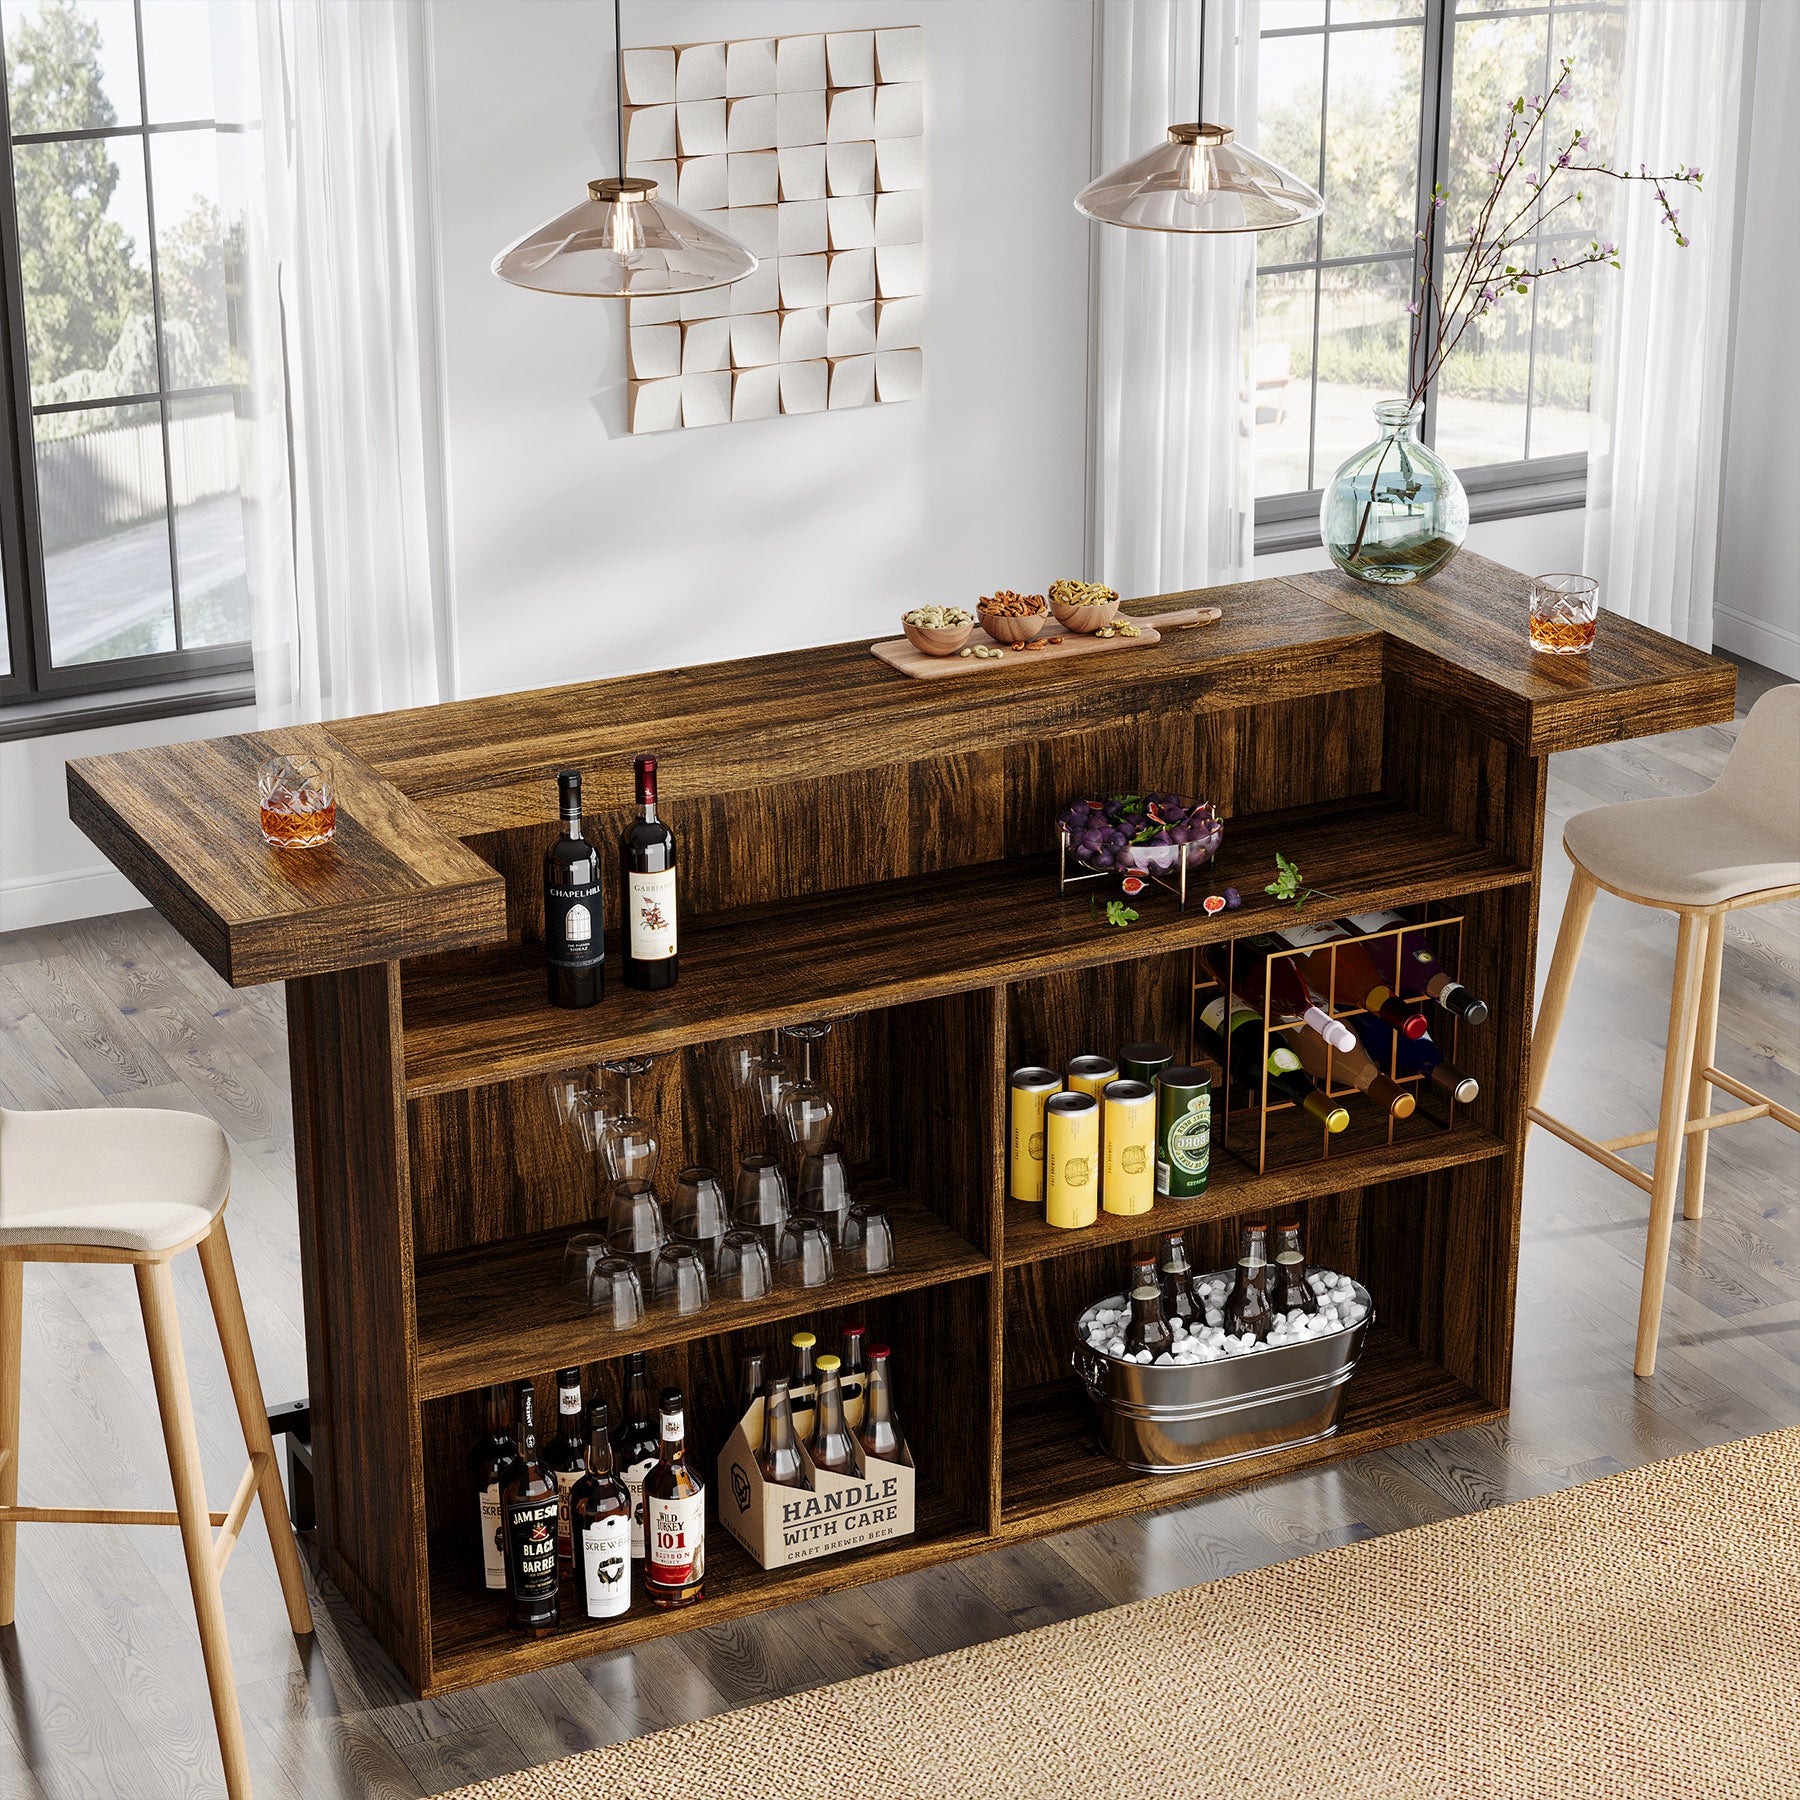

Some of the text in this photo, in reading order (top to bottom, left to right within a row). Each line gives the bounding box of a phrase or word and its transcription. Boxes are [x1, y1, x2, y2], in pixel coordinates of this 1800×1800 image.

[550, 885, 601, 898] CHAPEL HILL
[783, 1477, 897, 1523] HANDLE
[656, 1518, 685, 1532] TURKEY
[659, 1511, 678, 1522] WILD
[783, 1505, 897, 1546] WITH CARE
[657, 1532, 686, 1549] 101
[788, 1528, 894, 1560] CRAFT BREWED BEER
